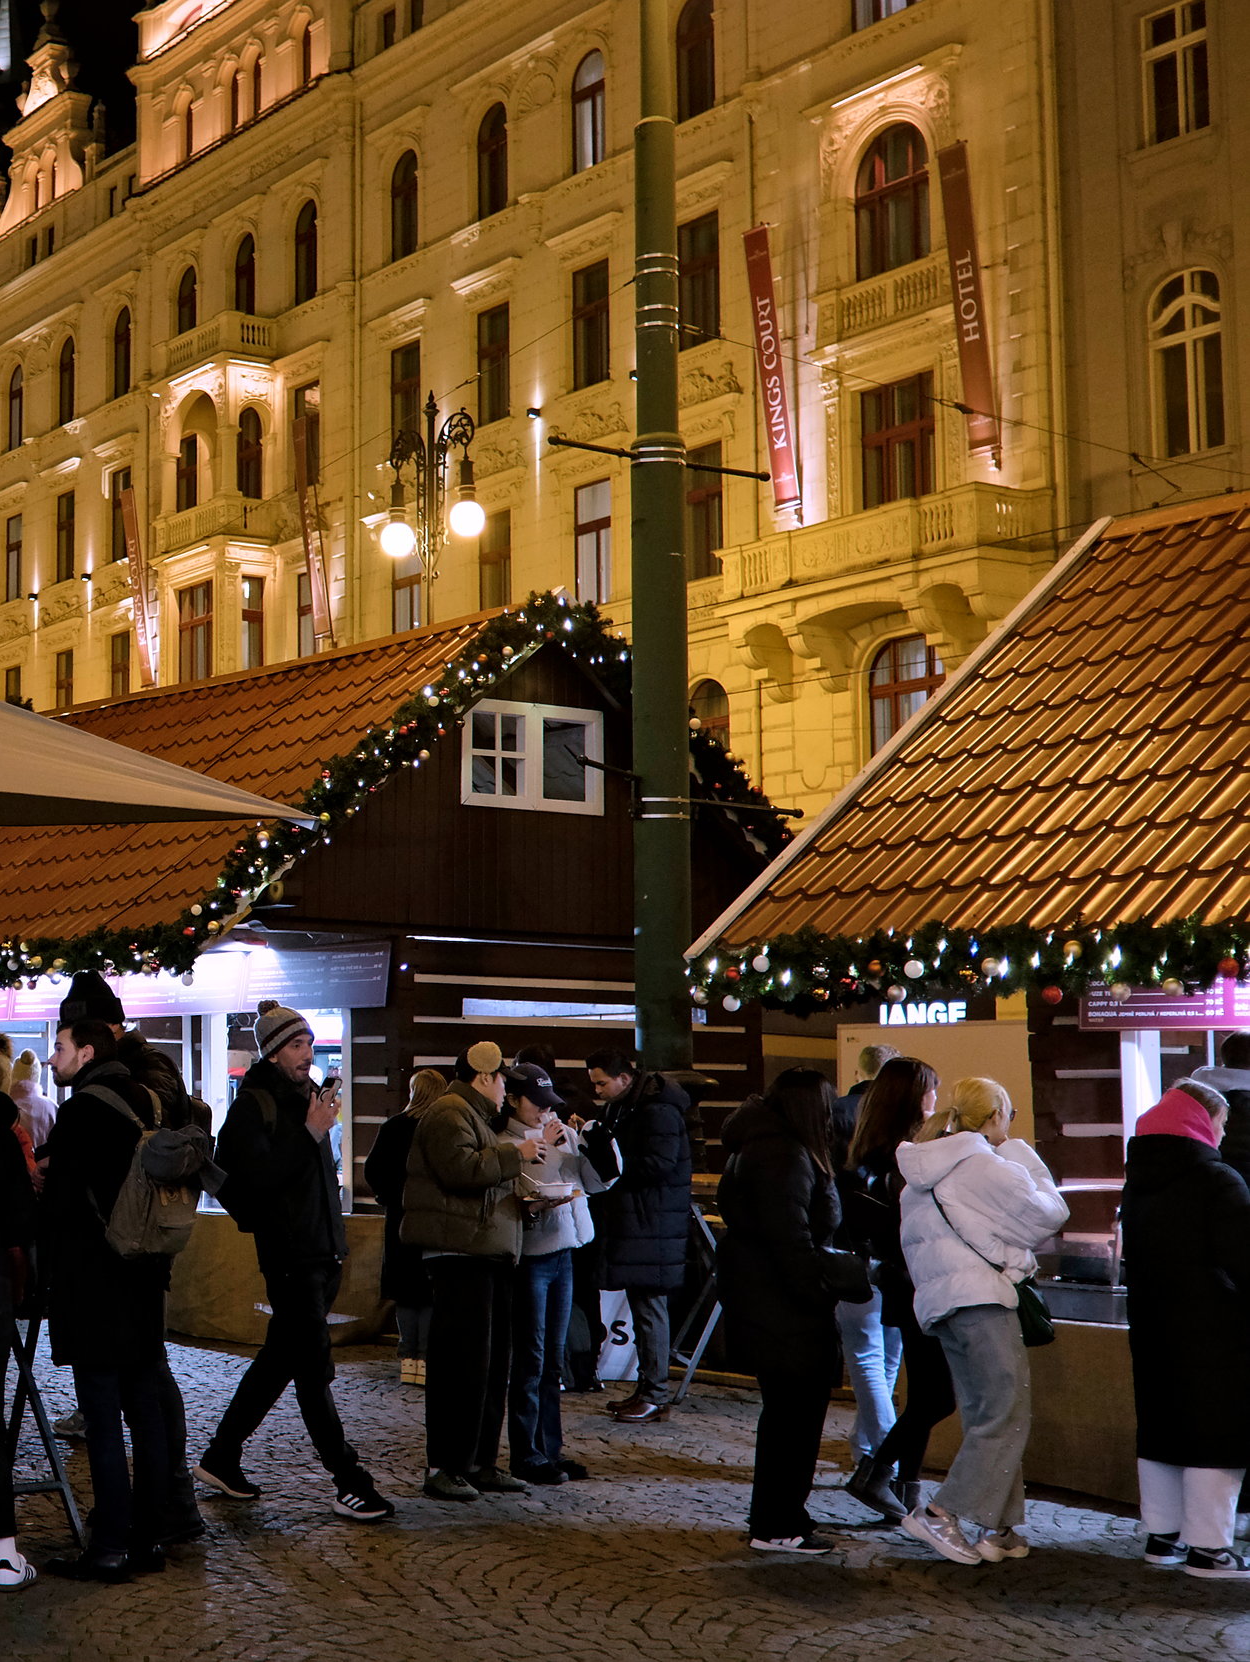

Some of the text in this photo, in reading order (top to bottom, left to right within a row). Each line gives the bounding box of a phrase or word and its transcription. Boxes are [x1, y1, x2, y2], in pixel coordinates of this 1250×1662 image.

[757, 296, 778, 370] COURT
[956, 249, 980, 343] HOTEL
[765, 375, 787, 451] KINGS
[134, 594, 147, 647] KINGS
